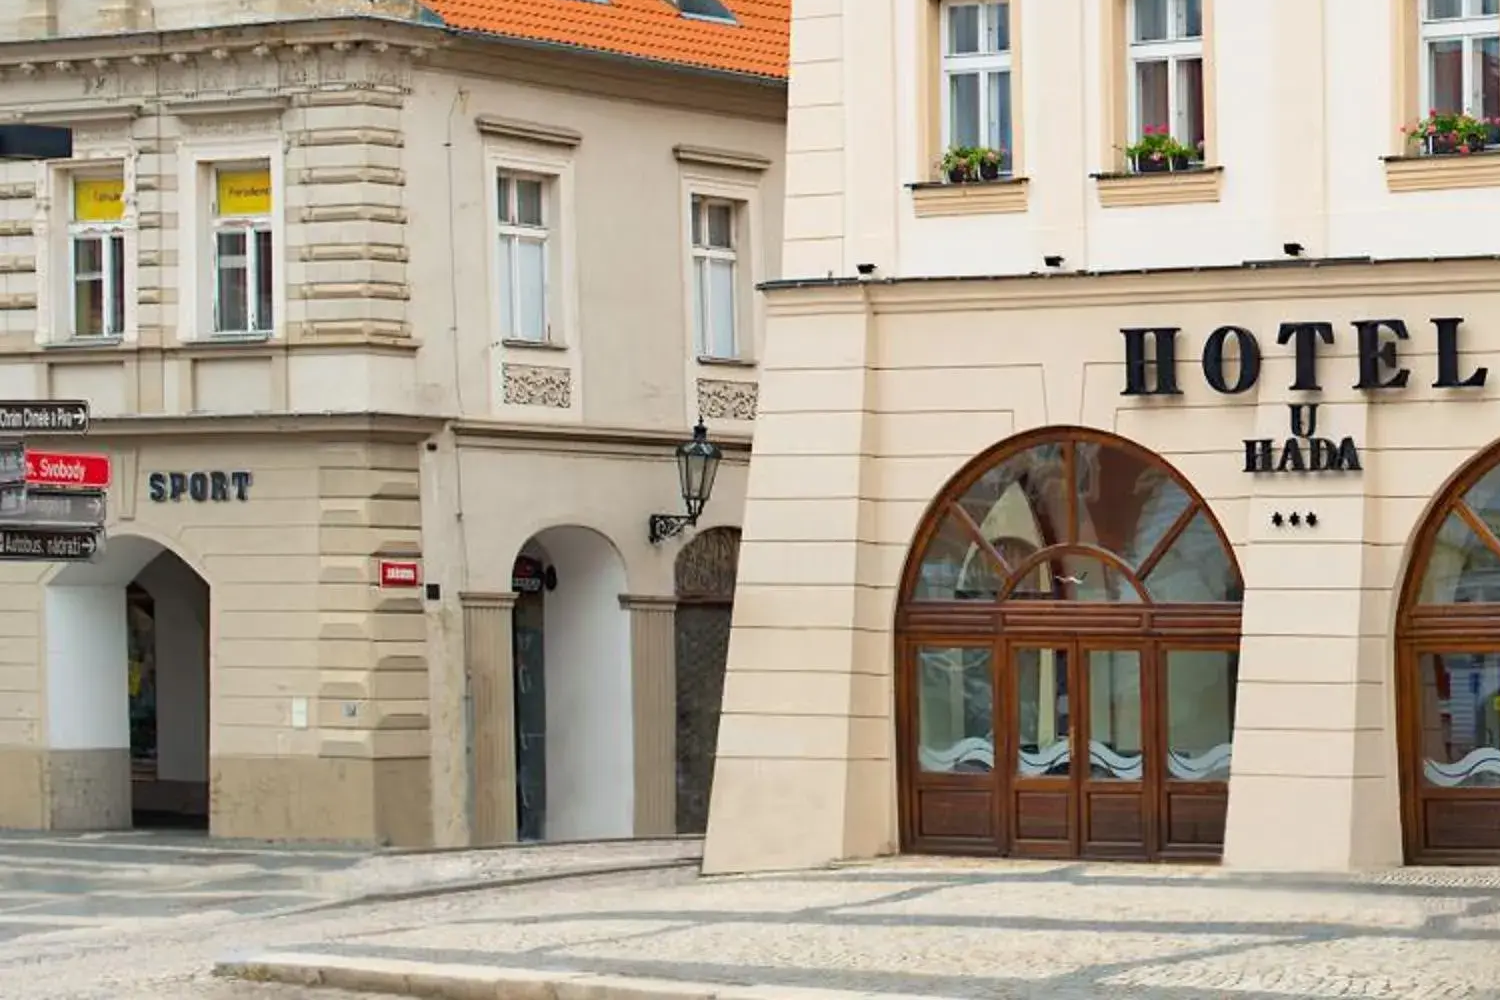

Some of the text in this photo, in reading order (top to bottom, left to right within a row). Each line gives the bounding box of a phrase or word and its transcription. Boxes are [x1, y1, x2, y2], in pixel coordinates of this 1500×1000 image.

[1119, 318, 1488, 396] HOTEL
[1287, 403, 1318, 437] U
[40, 458, 87, 482] Svobody
[1242, 436, 1363, 473] HADA
[149, 471, 252, 502] SPORT
